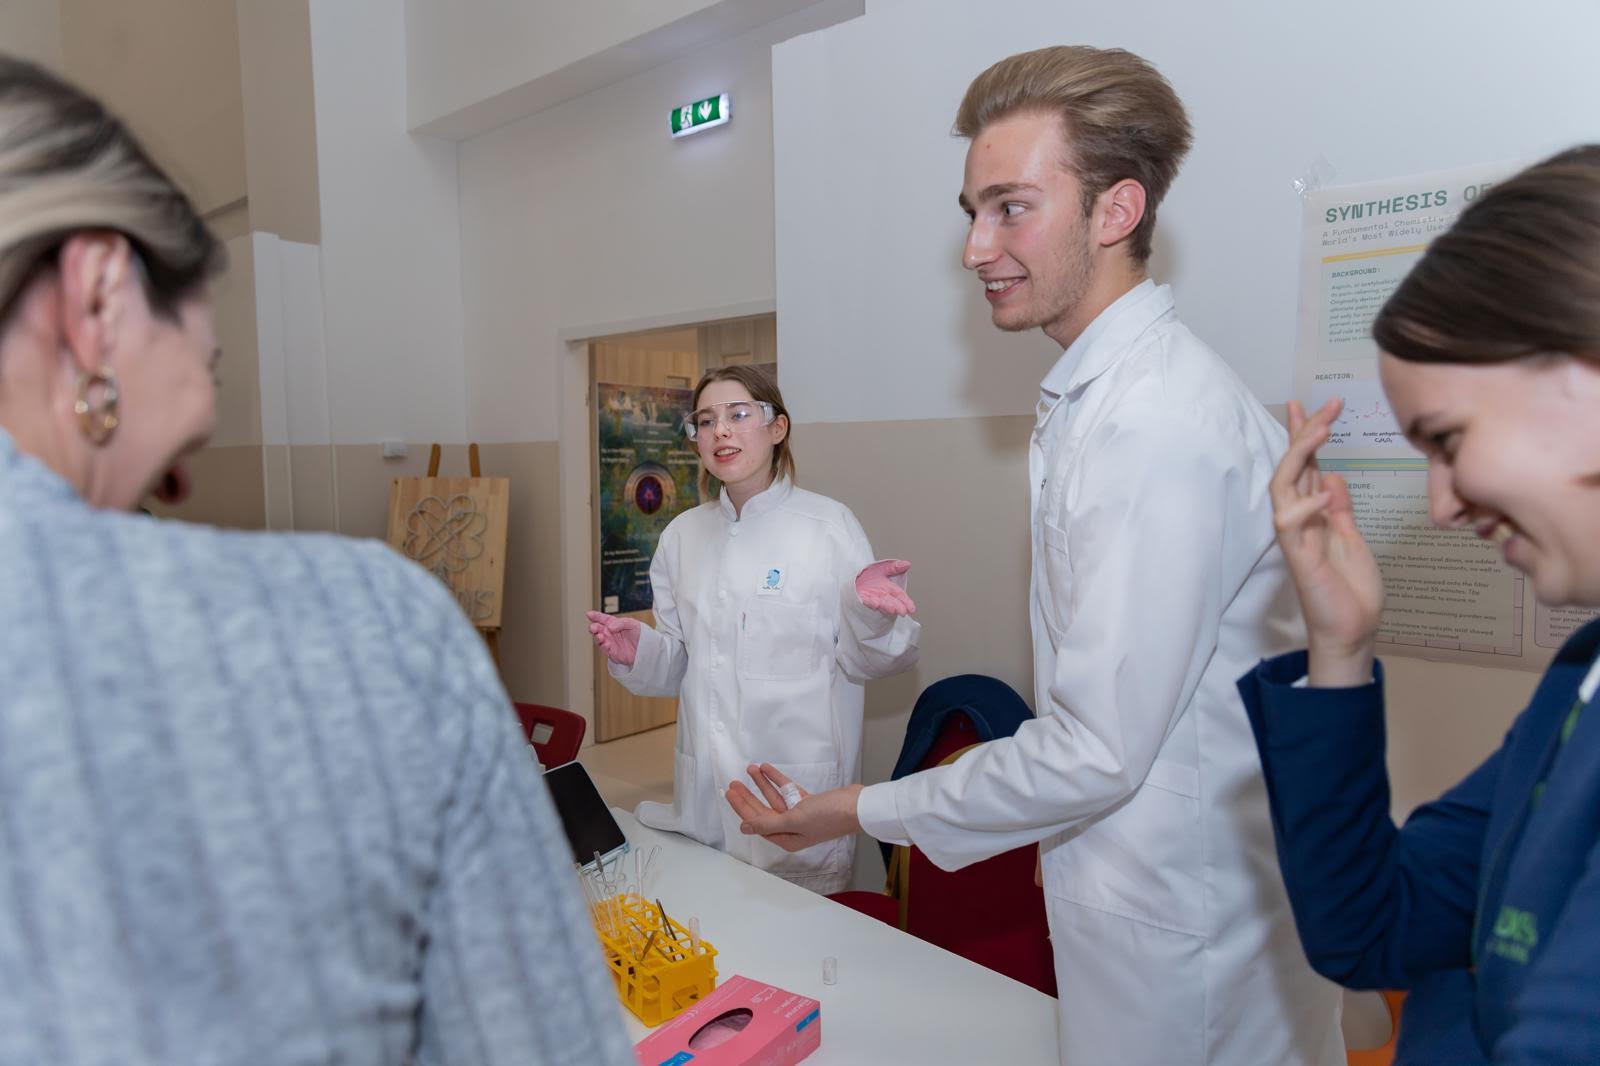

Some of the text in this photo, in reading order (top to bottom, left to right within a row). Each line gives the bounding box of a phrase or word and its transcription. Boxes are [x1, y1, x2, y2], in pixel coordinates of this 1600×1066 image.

[1325, 189, 1449, 224] SYNTHESIS
[1321, 234, 1357, 248] World's
[1361, 231, 1384, 242] Most
[1388, 225, 1422, 239] Widely
[1322, 231, 1329, 239] A
[1332, 222, 1389, 237] Fundamental
[1331, 266, 1383, 279] BACKGROUND:
[1314, 372, 1354, 382] REACTION:
